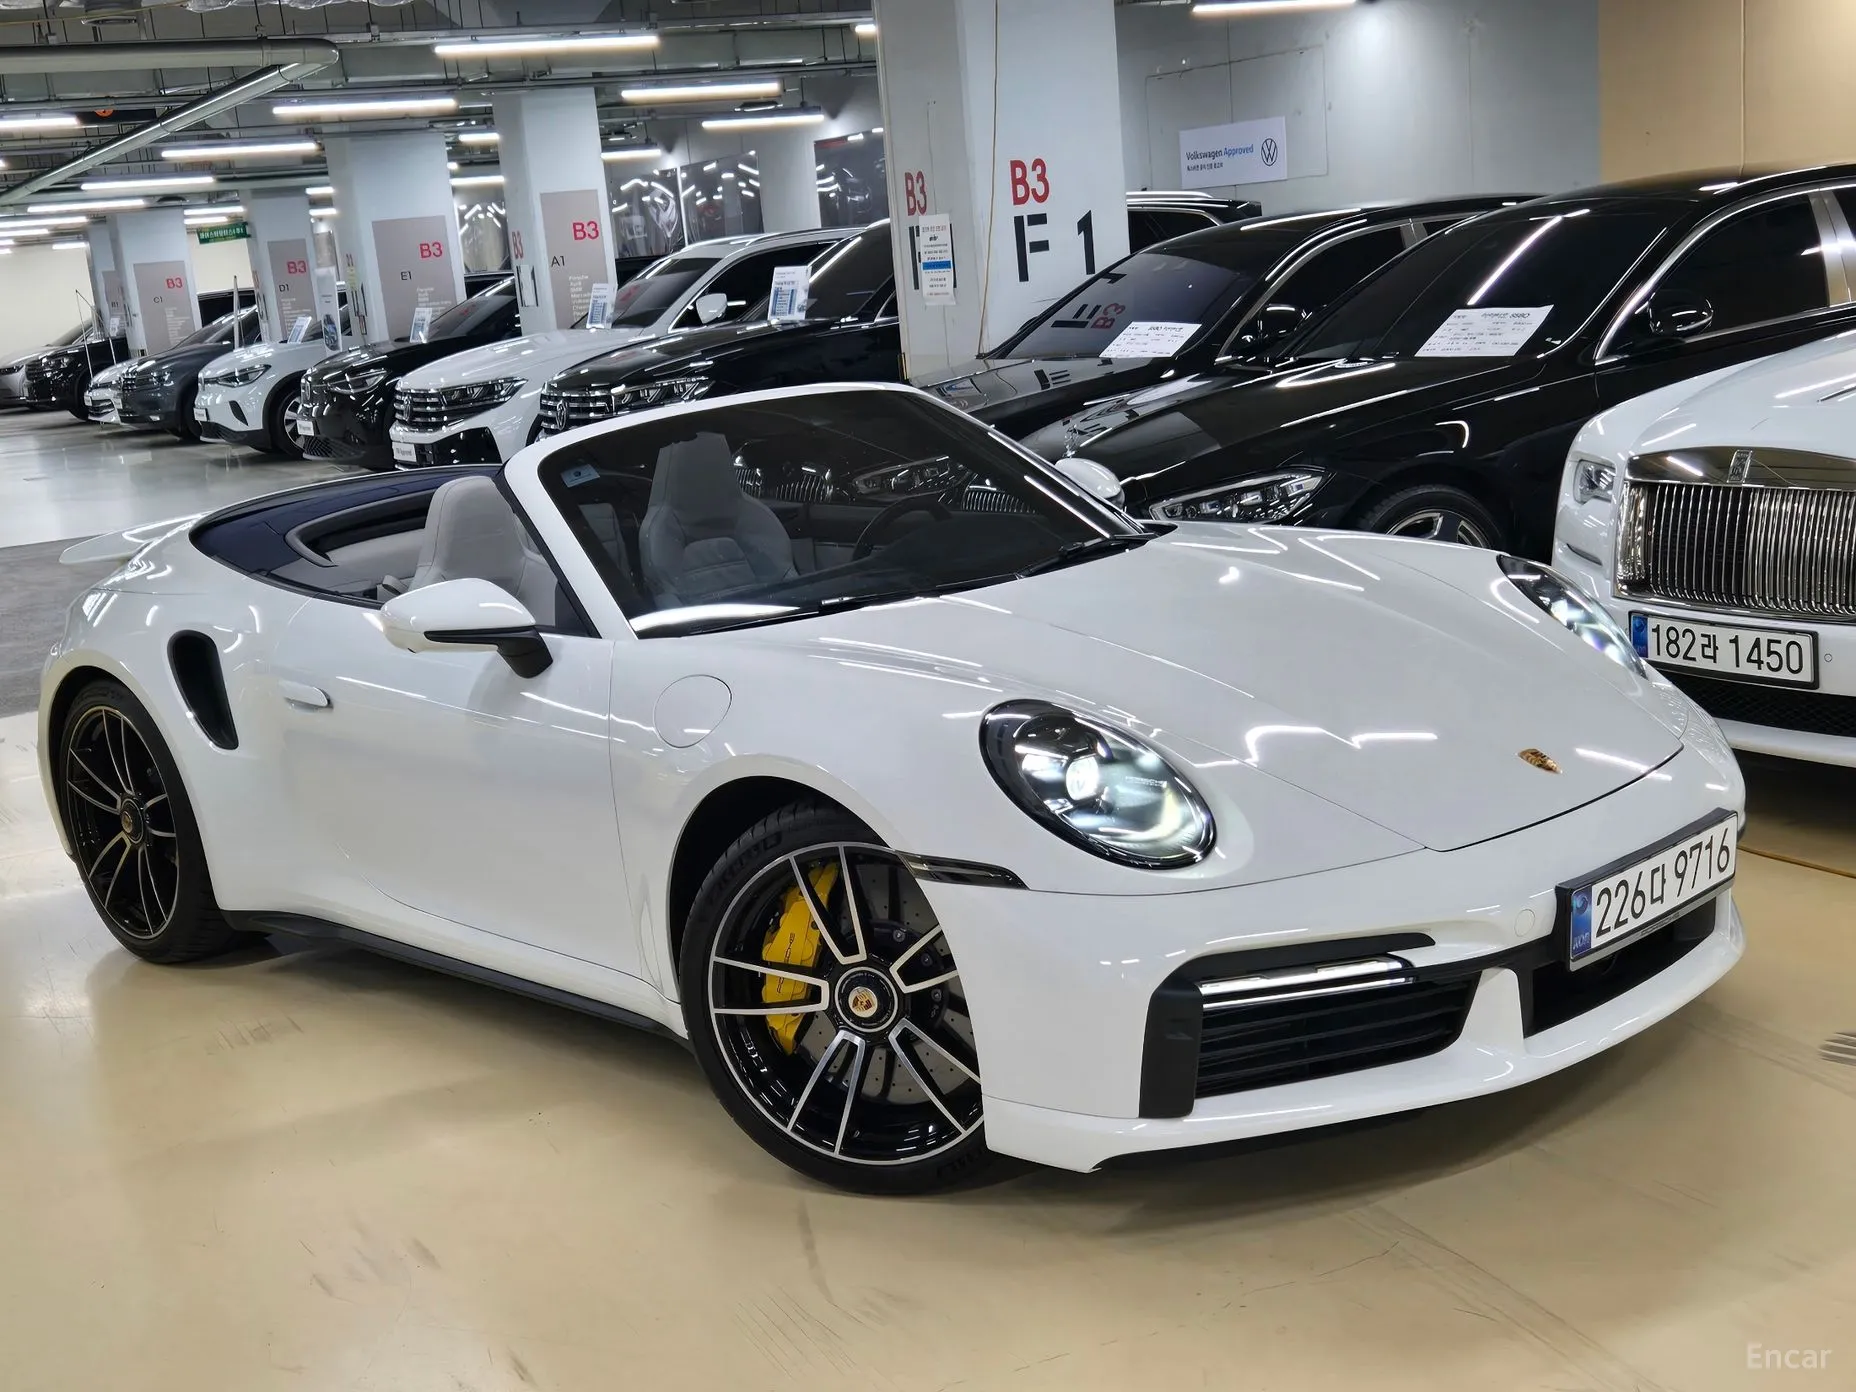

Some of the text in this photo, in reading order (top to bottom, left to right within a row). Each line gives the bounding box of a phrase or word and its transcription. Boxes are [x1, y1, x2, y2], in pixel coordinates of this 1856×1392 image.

[1186, 144, 1254, 160] Volkswagen Approved
[1010, 158, 1050, 205] B3
[904, 171, 927, 216] B3
[573, 221, 599, 240] B3
[419, 242, 443, 259] B3
[512, 231, 524, 259] B3
[1014, 210, 1096, 282] F 1
[287, 260, 307, 275] B3
[551, 255, 565, 267] A1
[166, 277, 183, 289] B3
[400, 271, 411, 280] E1
[279, 284, 290, 292] D1
[1651, 624, 1804, 675] 182라 1450
[1596, 828, 1730, 938] 226다 9716
